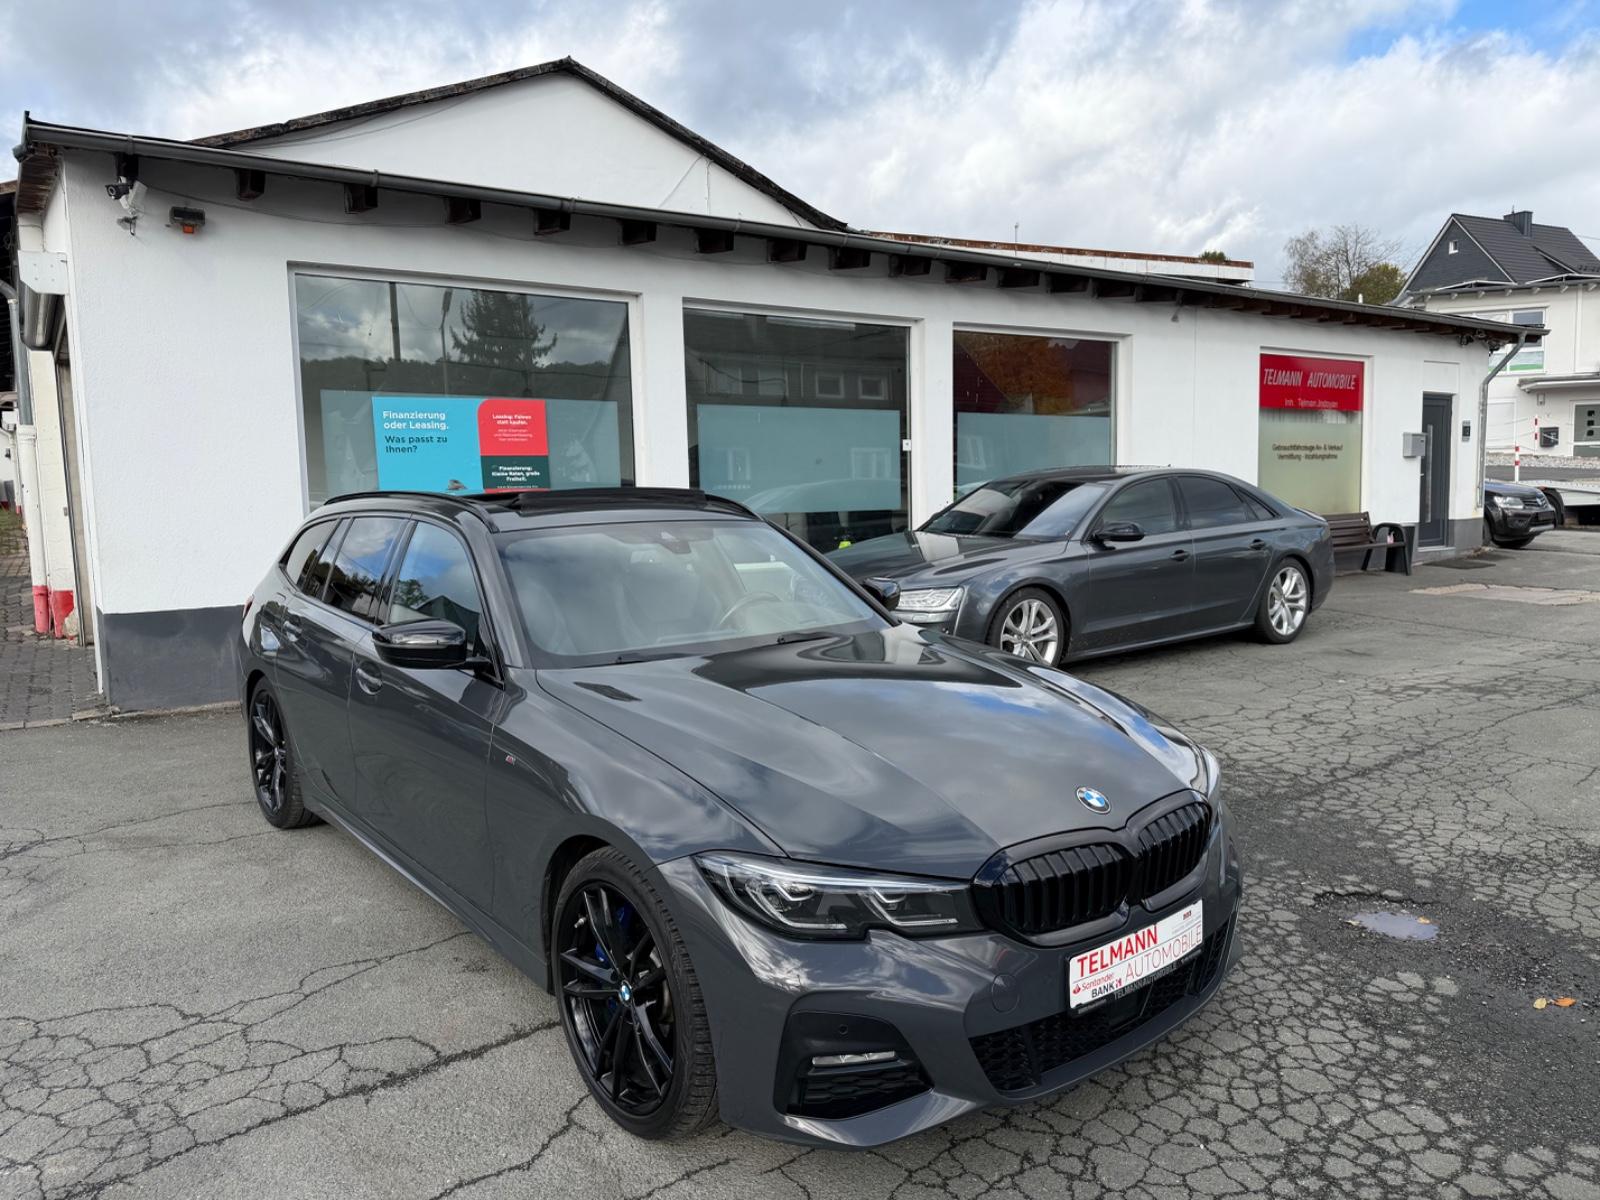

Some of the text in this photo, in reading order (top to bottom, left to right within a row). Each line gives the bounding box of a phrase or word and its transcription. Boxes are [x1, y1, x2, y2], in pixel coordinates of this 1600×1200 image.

[1263, 368, 1356, 390] TELMANN AUTOMOBILE
[382, 410, 446, 420] Finanzierung
[383, 420, 449, 431] oder Leasing.
[384, 435, 406, 443] Was
[408, 435, 435, 445] passt
[385, 445, 418, 454] Ihnen?
[1076, 924, 1158, 978] TELMANN
[1125, 924, 1201, 982] AUTOMOBILE
[1081, 972, 1114, 991] Santander
[1091, 981, 1115, 998] BANK
